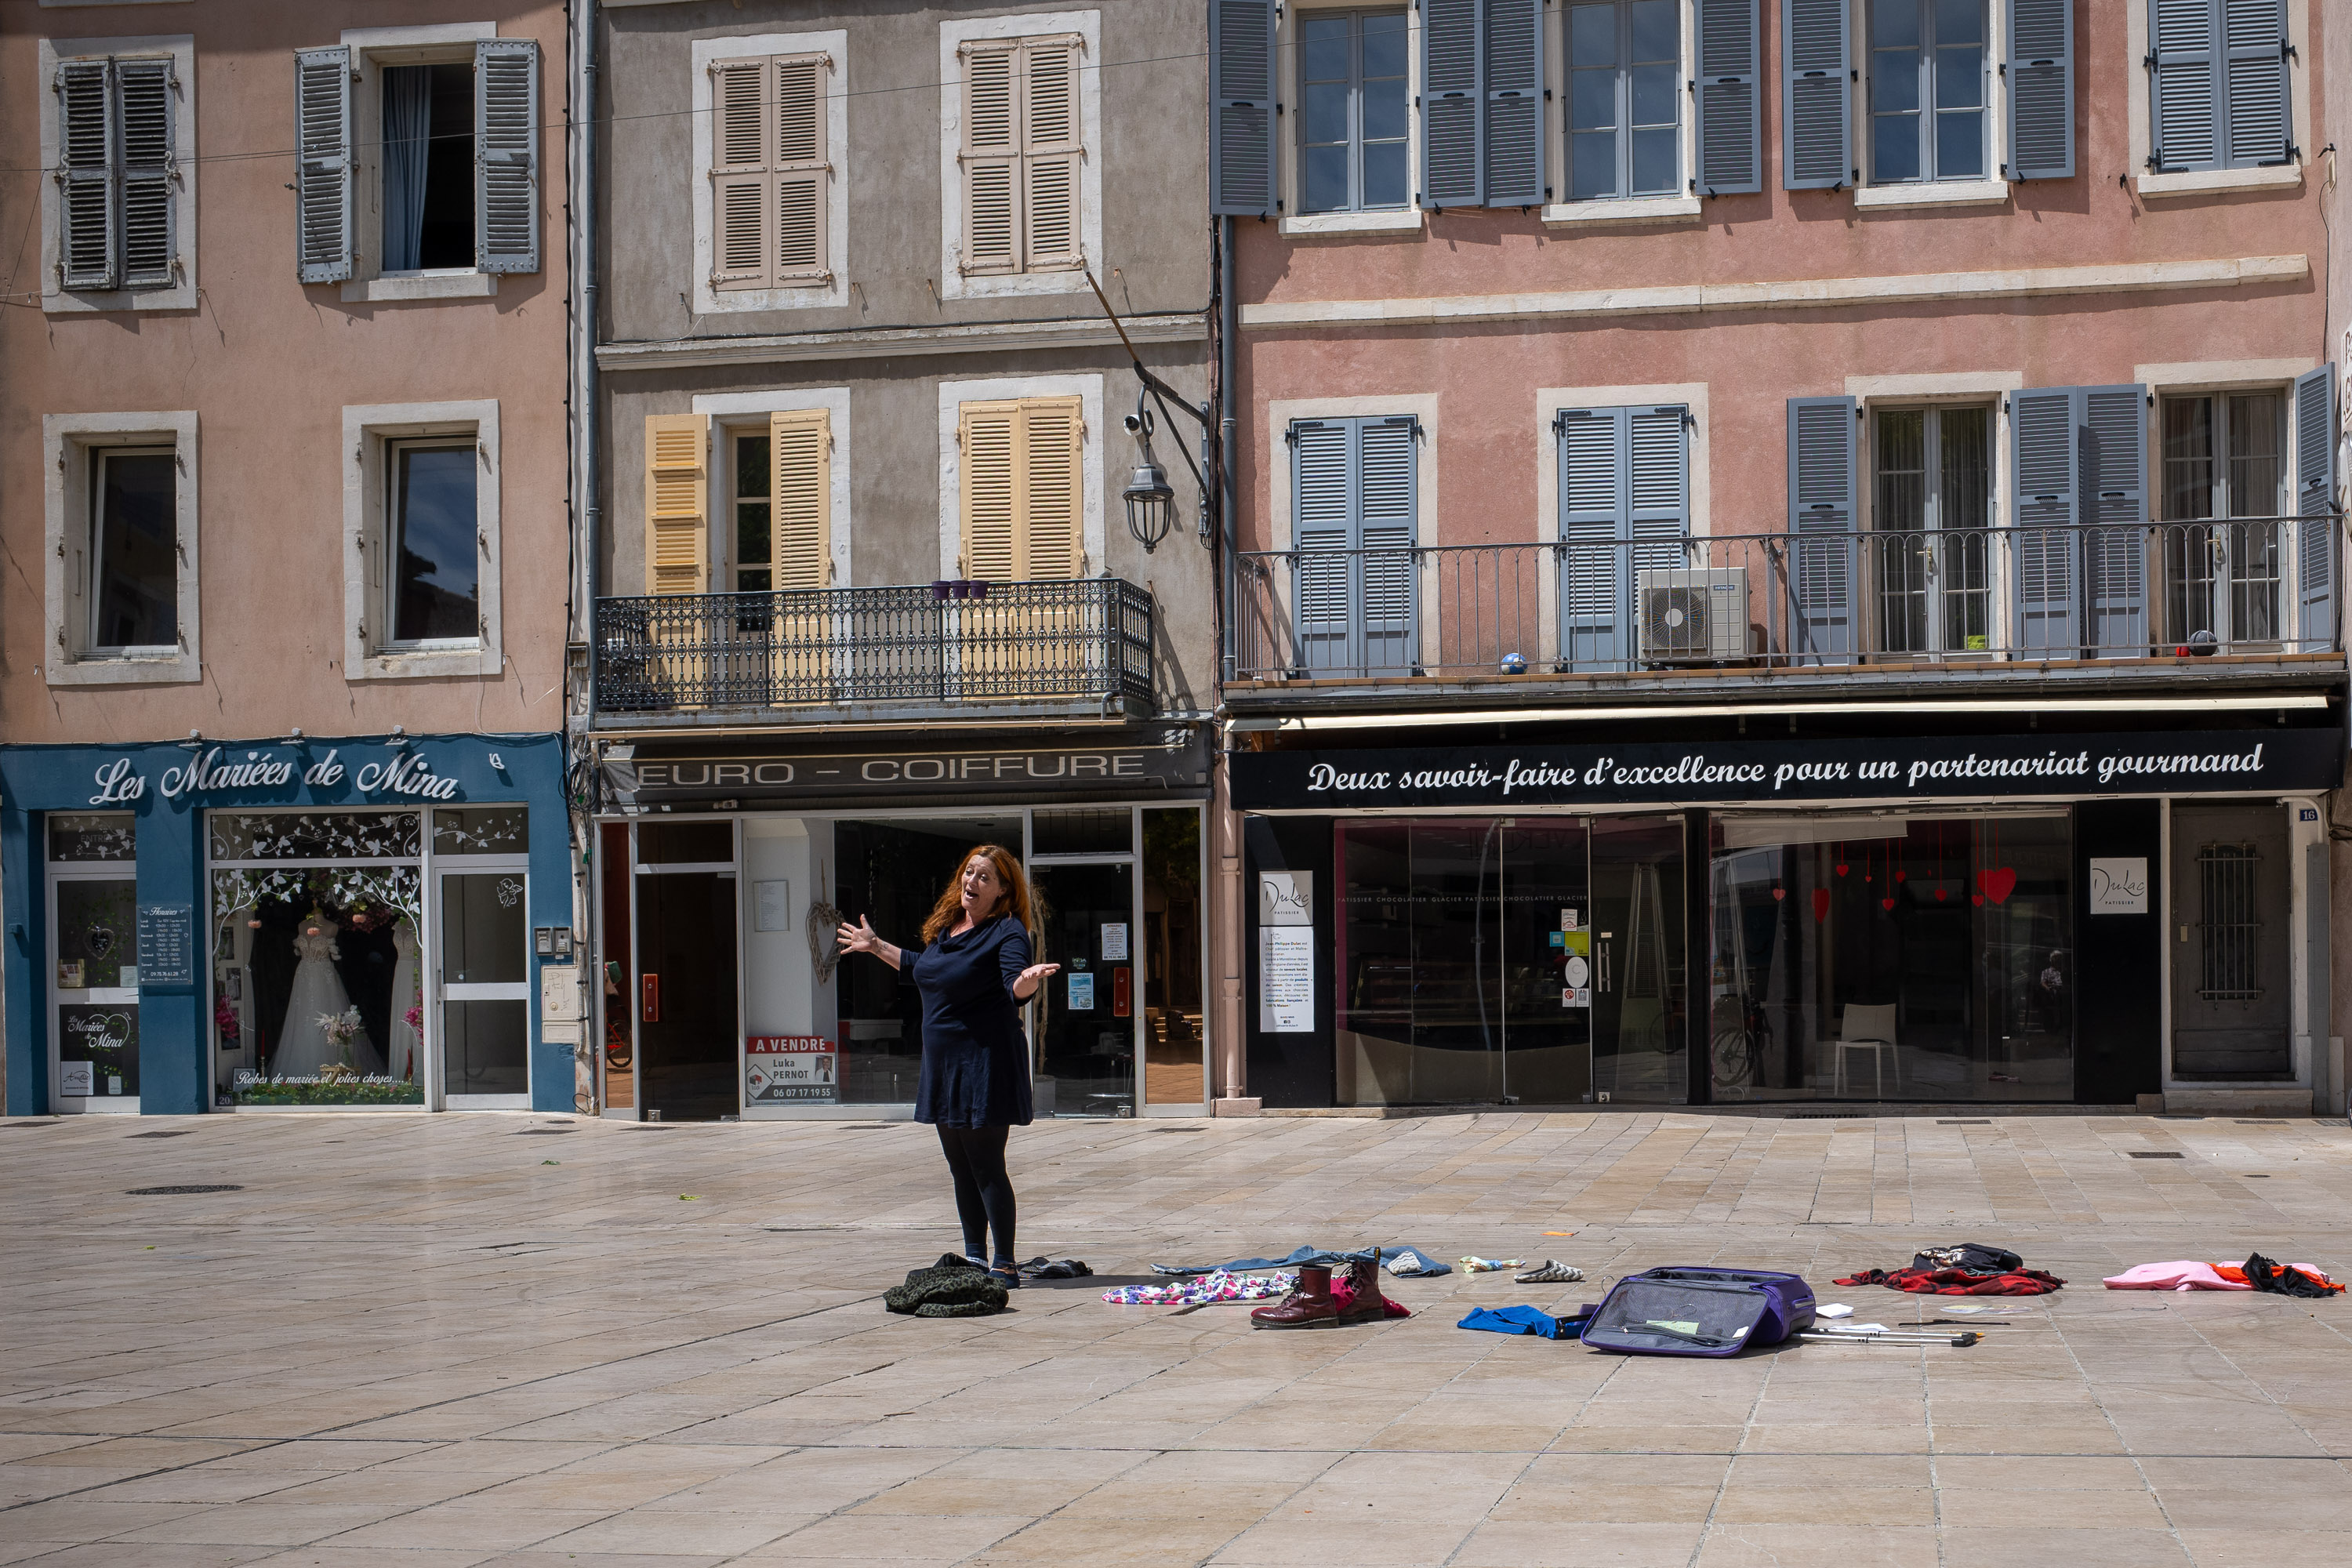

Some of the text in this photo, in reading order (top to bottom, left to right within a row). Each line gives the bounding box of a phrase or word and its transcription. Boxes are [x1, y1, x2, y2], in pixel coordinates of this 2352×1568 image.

[89, 746, 459, 804] Les Mariées de Mina
[637, 764, 794, 784] EURO
[862, 755, 1145, 782] COIFFURE
[1307, 743, 2264, 795] Deux savoir-faire d'excellence pour un partenariat gourmand
[2303, 810, 2315, 820] 16
[150, 906, 177, 916] Horaires
[67, 1018, 106, 1033] Mariées
[89, 1032, 124, 1048] Mina
[755, 1038, 826, 1052] A VENDRE
[773, 1058, 795, 1068] Luka
[235, 1071, 268, 1084] Robes
[271, 1073, 284, 1084] de
[285, 1073, 318, 1084] mariée
[320, 1072, 332, 1084] et
[329, 1072, 360, 1087] jolies
[773, 1070, 809, 1080] PERNOT
[773, 1088, 784, 1097] 06
[786, 1088, 797, 1097] 07
[798, 1088, 808, 1097] 17
[811, 1088, 820, 1097] 19
[220, 1096, 230, 1105] 20
